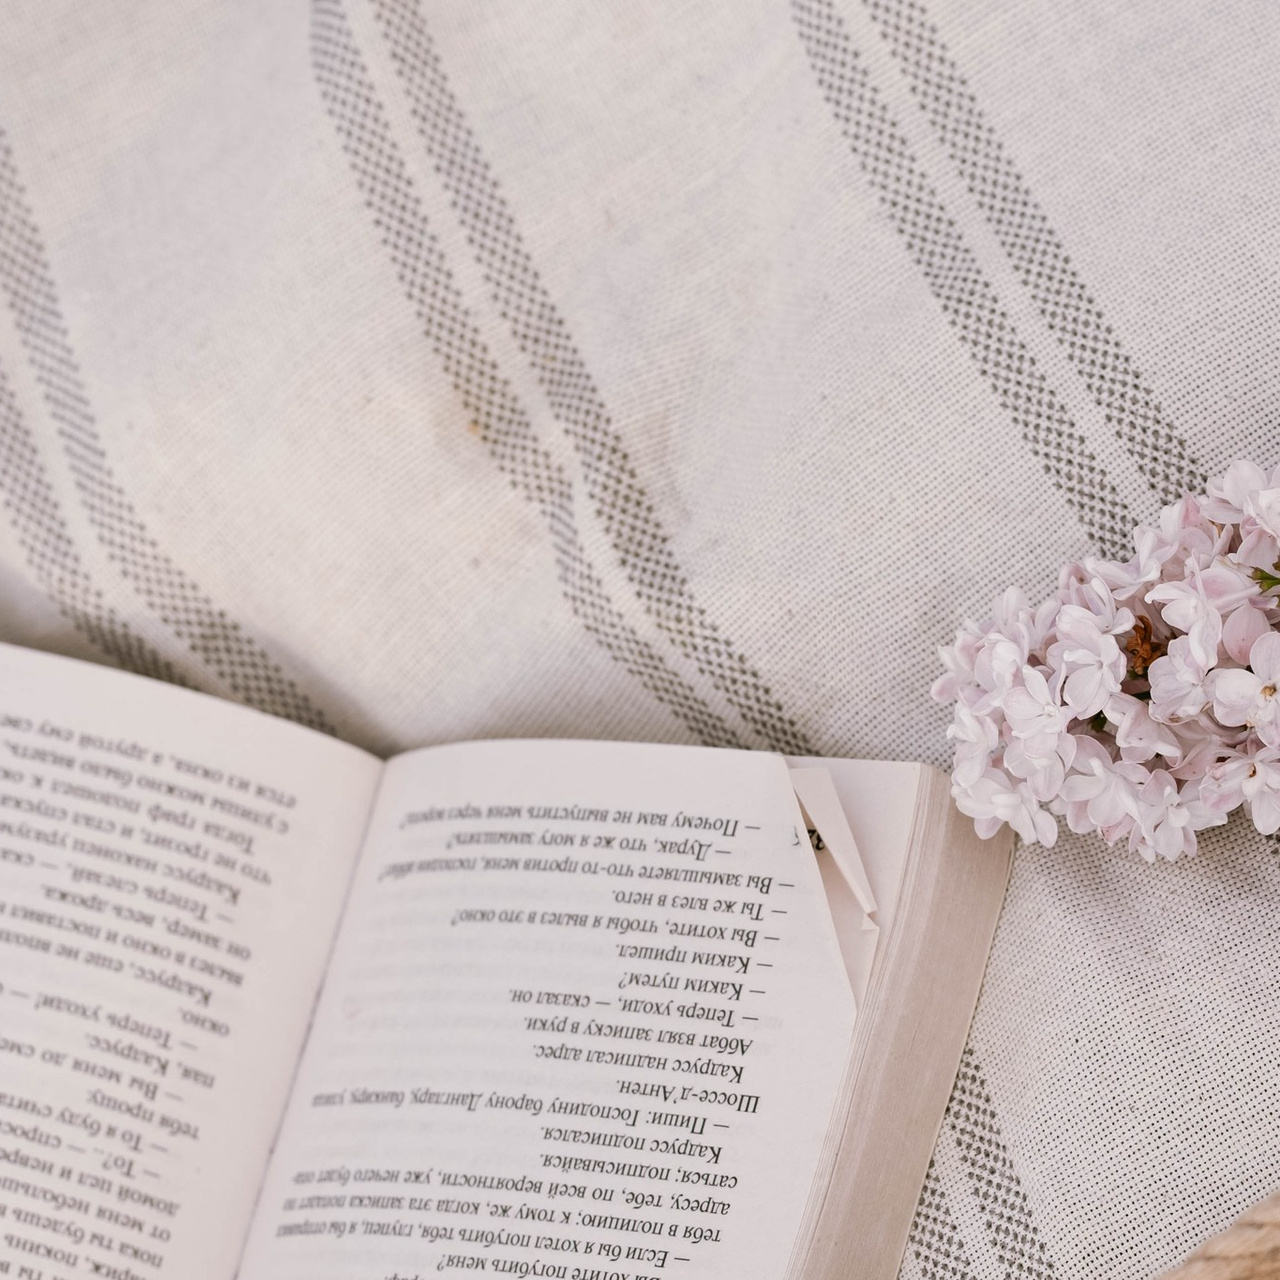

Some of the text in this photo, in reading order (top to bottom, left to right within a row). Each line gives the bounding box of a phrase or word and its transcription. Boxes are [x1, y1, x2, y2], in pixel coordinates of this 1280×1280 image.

[635, 810, 739, 837] Почему вам
[618, 837, 712, 861] Дурак, что
[580, 860, 743, 887] замышляете что-то
[611, 889, 709, 911] влез него.
[539, 911, 728, 940] хотите, чтобы вылез
[615, 943, 751, 974] Каким пришел.
[617, 971, 743, 1001] Каким путем?
[534, 990, 734, 1028] Теперь уходи, сказал
[105, 1012, 171, 1050] Теперь
[523, 1015, 753, 1056] Аббат взял записку руки.
[70, 1057, 159, 1101] Вы меня
[532, 1042, 744, 1084] Кадрусс надписал адрес.
[484, 1090, 707, 1135] Пиши: Господину барону
[615, 1079, 760, 1113] Шоссе-д’Антен.
[55, 1106, 142, 1153] То буду
[157, 1113, 199, 1140] тебя
[540, 1126, 722, 1164] Кадрусс подписался.
[539, 1153, 738, 1189] саться; подписывайся.
[76, 1171, 180, 1217] домой цел
[437, 1170, 731, 1215] адресу, тебе, всей вероятности,
[11, 1207, 163, 1268] пока будешь
[95, 1205, 171, 1242] от меня
[435, 1198, 721, 1244] тебя полицию; тому когда
[457, 1227, 669, 1268] Если хотел погубить
[490, 1258, 567, 1279] погубить
